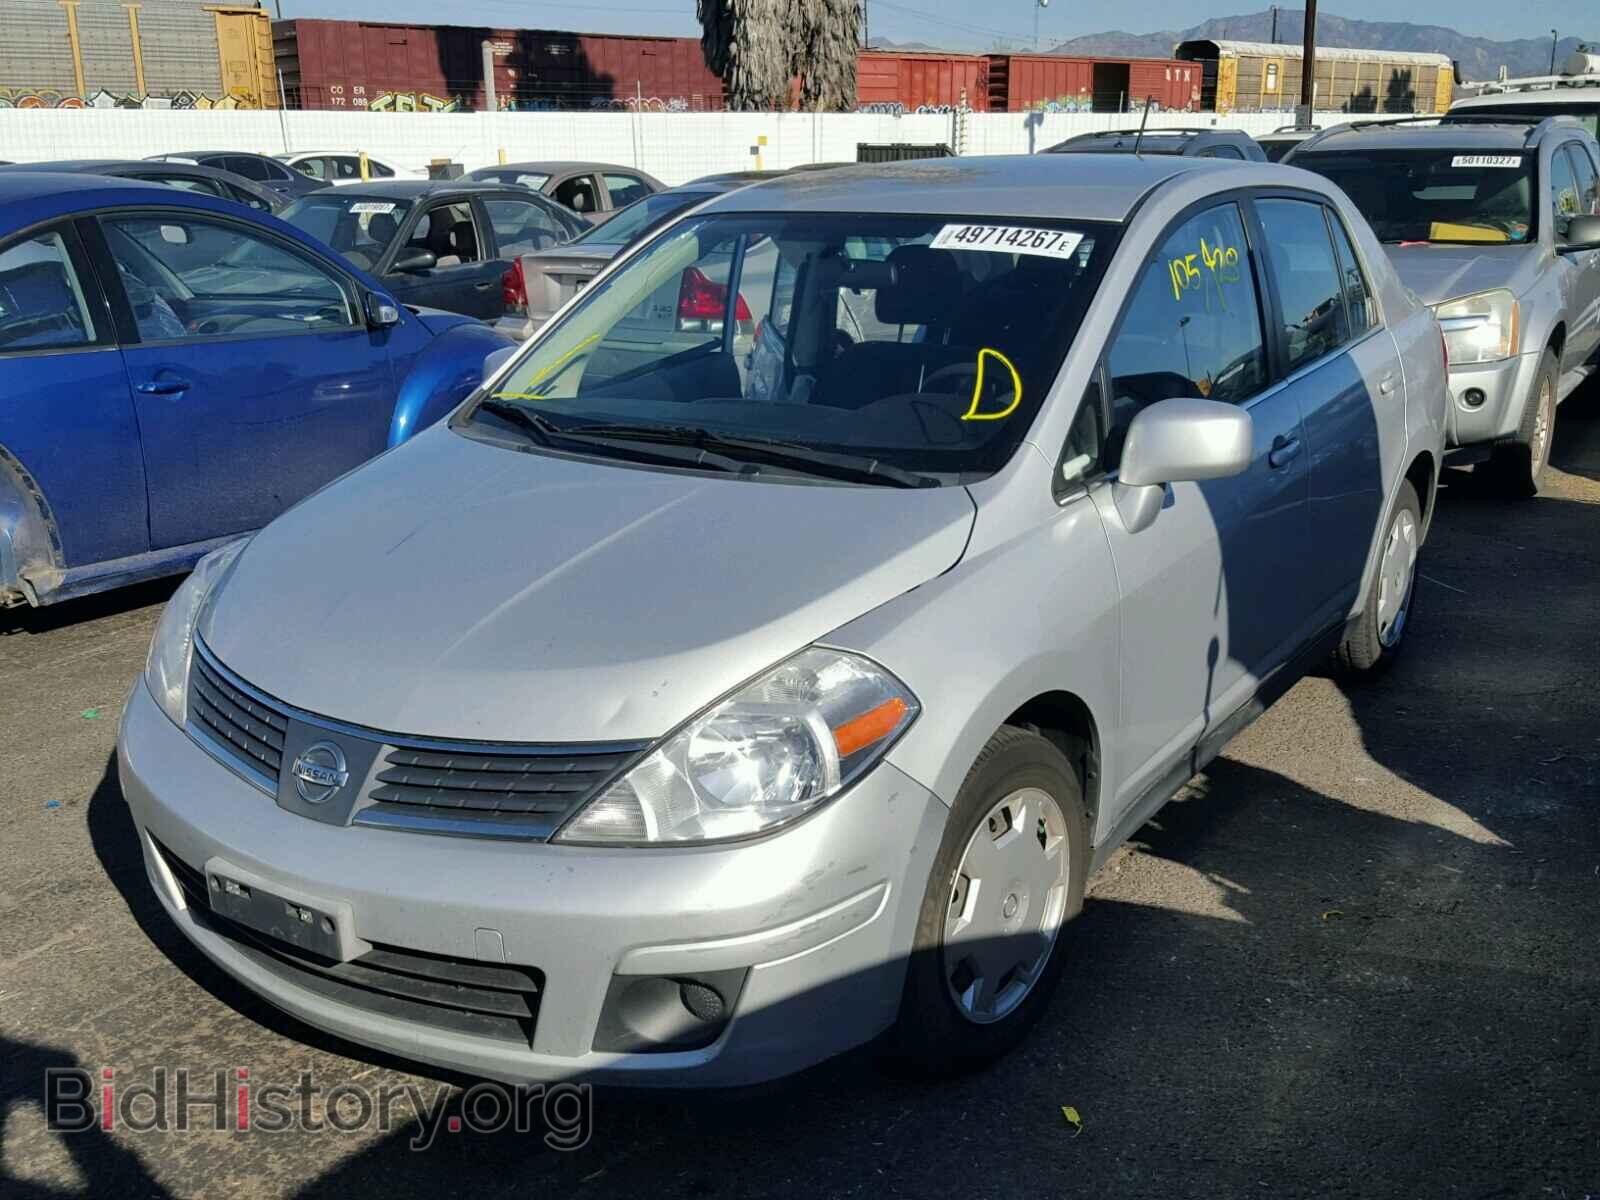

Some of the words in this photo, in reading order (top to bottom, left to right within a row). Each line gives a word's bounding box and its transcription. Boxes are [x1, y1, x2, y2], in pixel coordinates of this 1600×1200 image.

[330, 86, 343, 95] CO
[353, 86, 365, 95] ER
[330, 97, 346, 106] 172
[960, 348, 1023, 420] D
[295, 761, 340, 786] NISSAN
